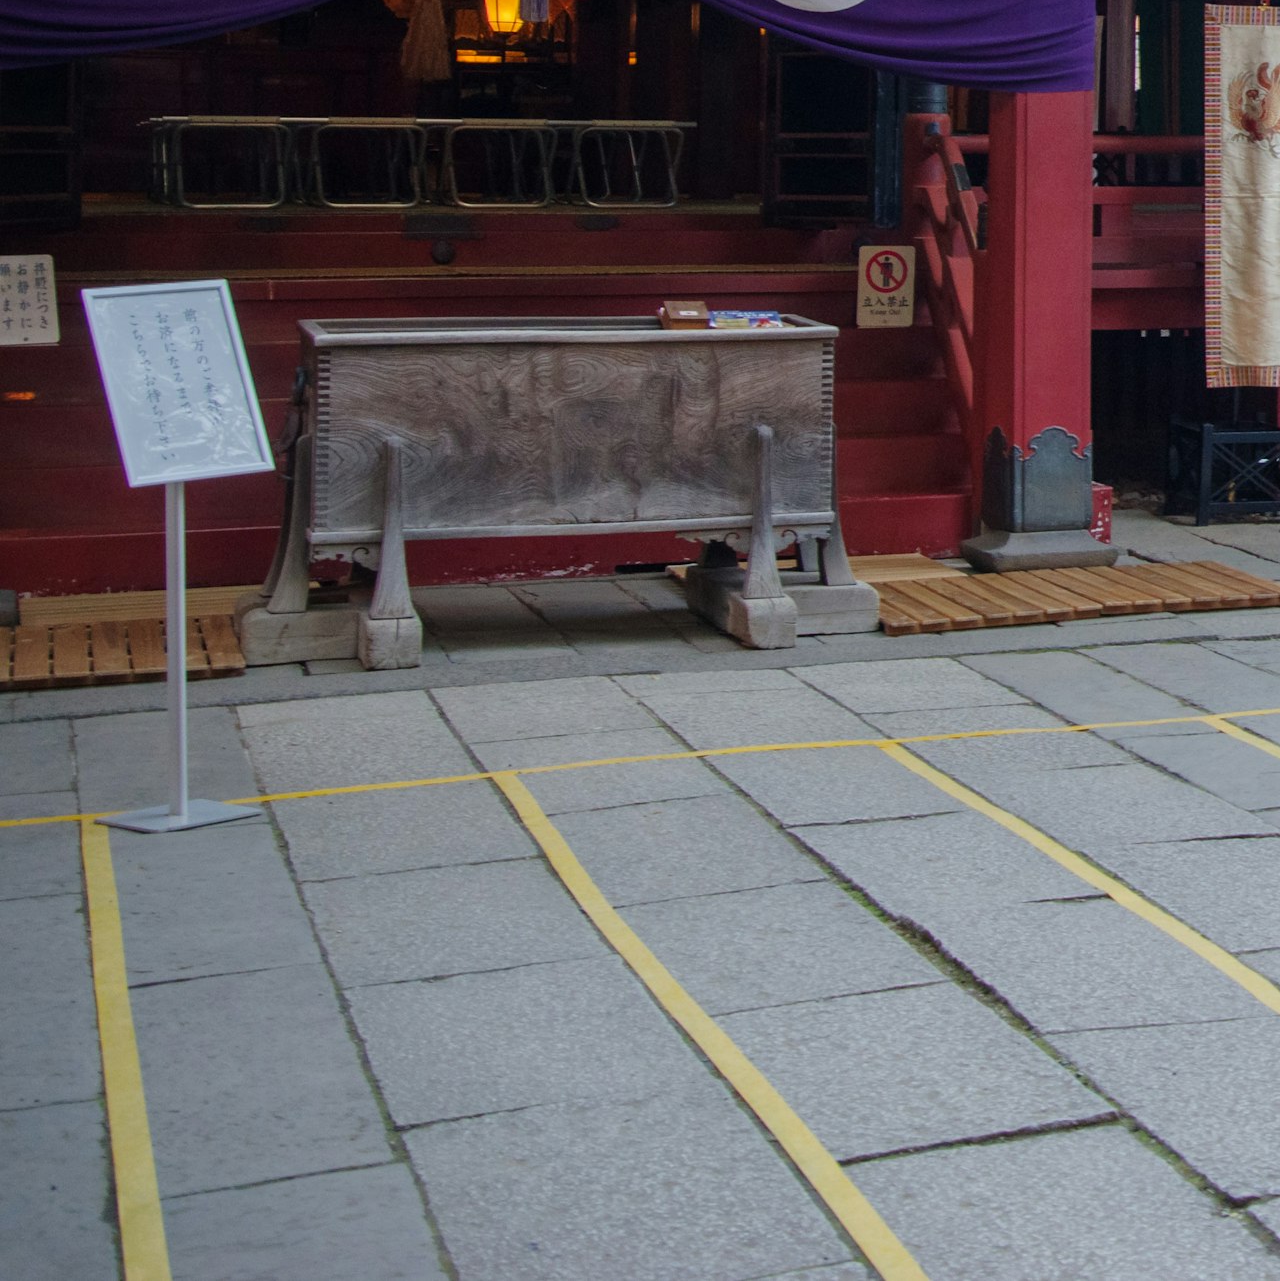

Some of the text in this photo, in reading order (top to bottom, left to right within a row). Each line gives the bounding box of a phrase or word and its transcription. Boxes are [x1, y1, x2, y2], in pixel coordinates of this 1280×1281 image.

[16, 263, 33, 329] お静かに
[862, 296, 910, 307] 立入禁止
[129, 315, 176, 461] こちらでお待ち下さい
